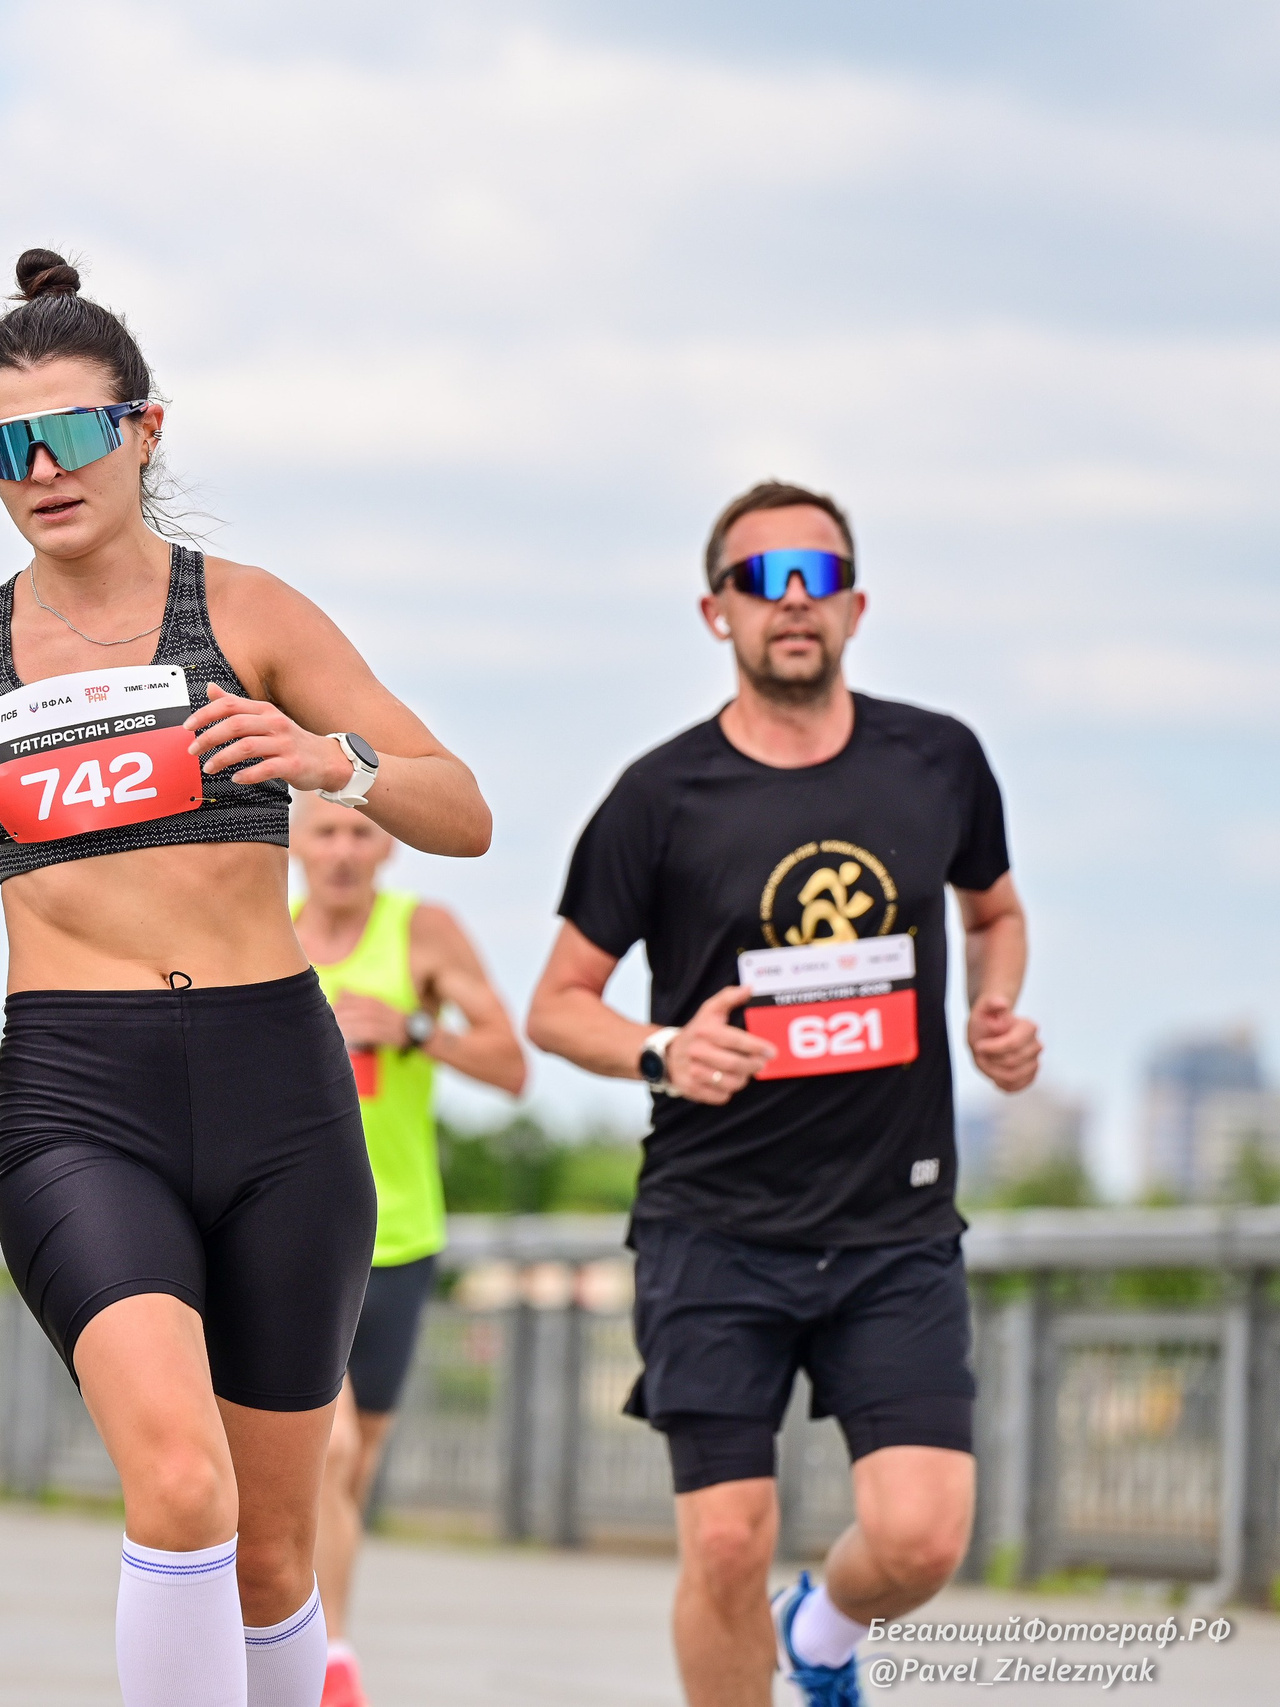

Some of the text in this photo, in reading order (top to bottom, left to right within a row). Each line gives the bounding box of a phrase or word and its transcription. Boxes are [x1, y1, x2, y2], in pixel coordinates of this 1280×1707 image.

[0, 709, 18, 722] ПСБ
[41, 696, 72, 709] ВФЛА
[10, 714, 157, 754] ТАТАРСТАН 2026
[20, 751, 158, 821] 742
[787, 1008, 883, 1060] 621
